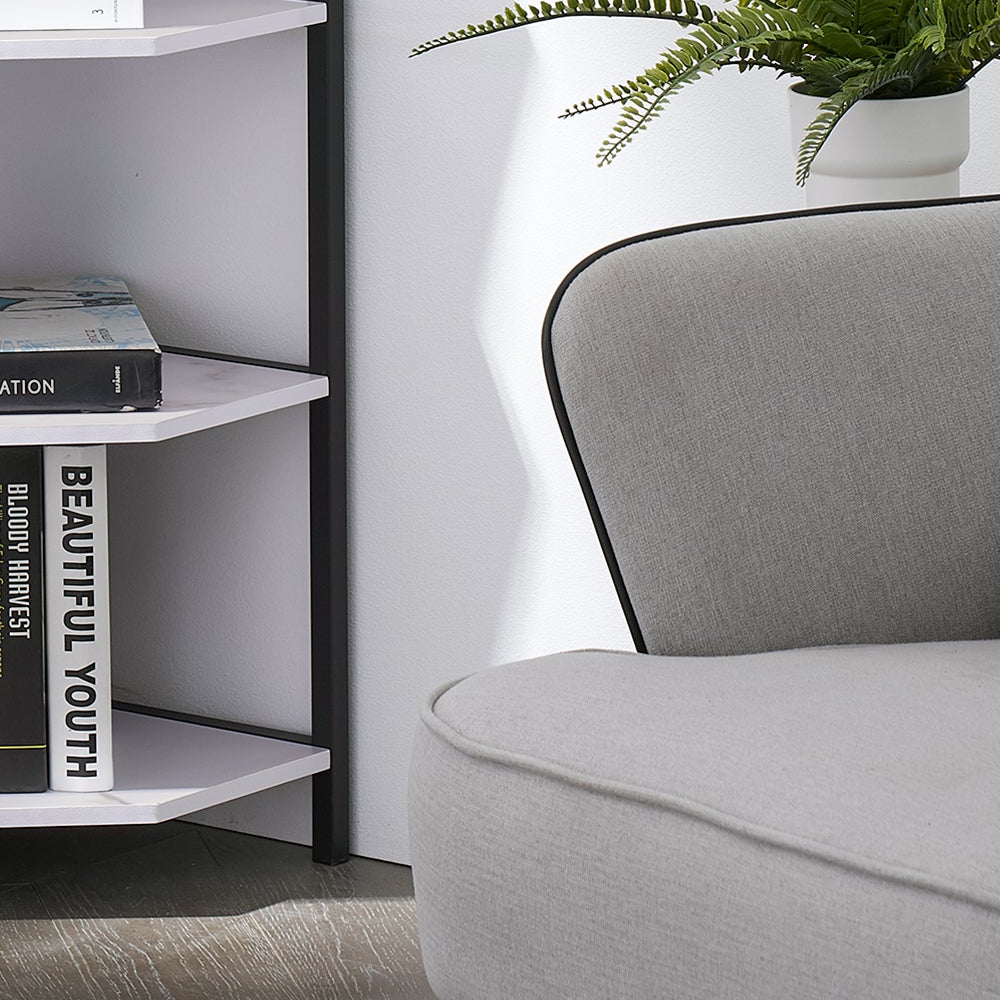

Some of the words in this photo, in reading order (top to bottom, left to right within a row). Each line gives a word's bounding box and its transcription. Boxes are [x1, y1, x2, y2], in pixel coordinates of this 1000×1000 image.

[7, 483, 30, 553] BLOODY
[60, 465, 96, 652] BEAUTIFUL
[8, 560, 31, 639] HARVEST
[64, 661, 98, 778] YOUTH
